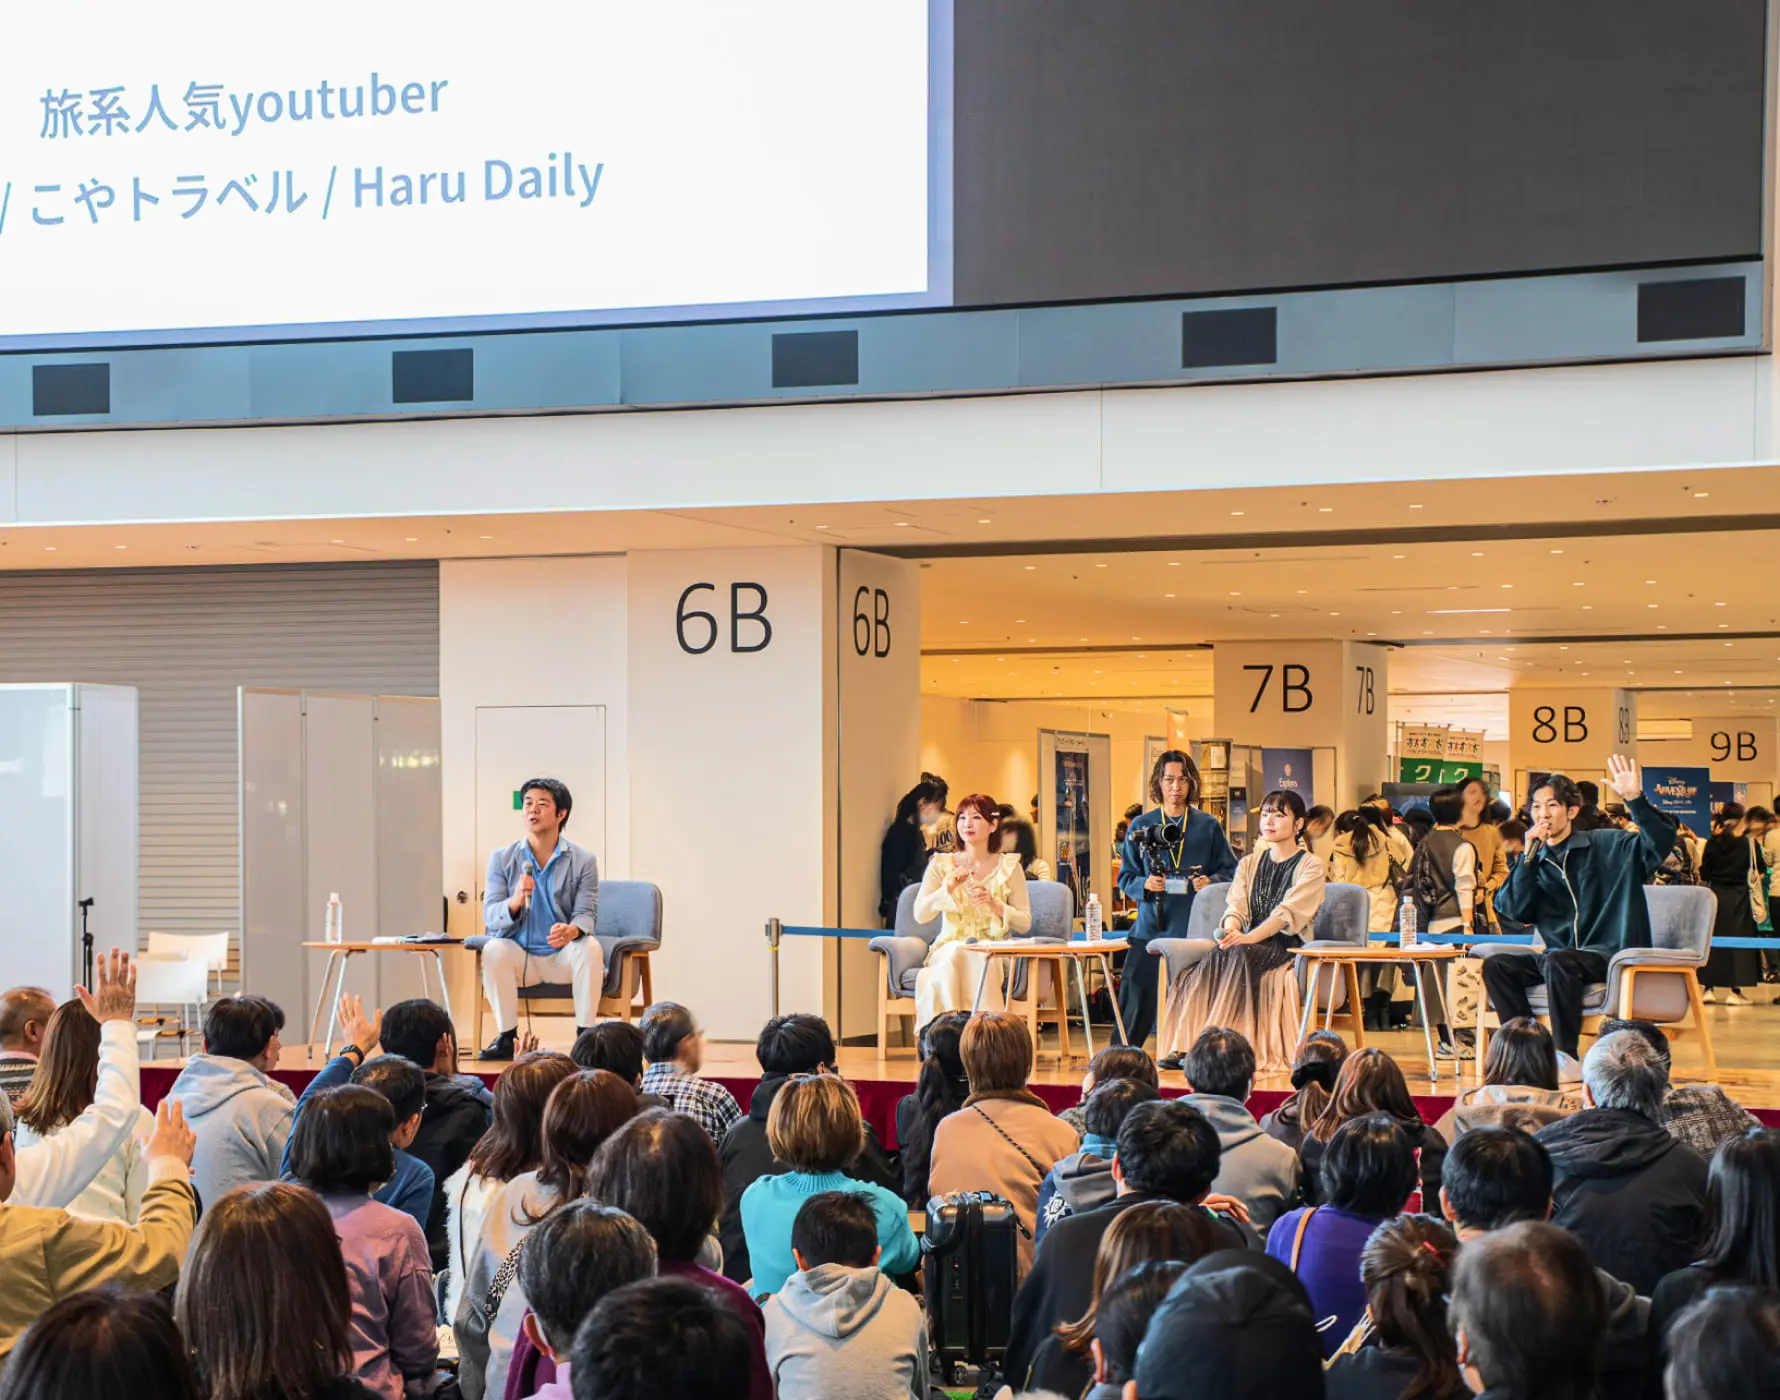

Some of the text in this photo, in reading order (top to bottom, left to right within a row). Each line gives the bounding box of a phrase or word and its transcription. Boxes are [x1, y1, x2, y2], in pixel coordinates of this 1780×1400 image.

[39, 71, 450, 140] 旅系人気youtuber
[31, 169, 309, 226] こやトラベル
[353, 165, 466, 209] Haru
[484, 151, 605, 209] Daily
[676, 582, 773, 655] 6B
[853, 585, 891, 659] 6B
[1243, 663, 1313, 713] 7B
[1355, 665, 1375, 716] 7B
[1532, 705, 1589, 744] 8B
[1710, 731, 1758, 762] 9B
